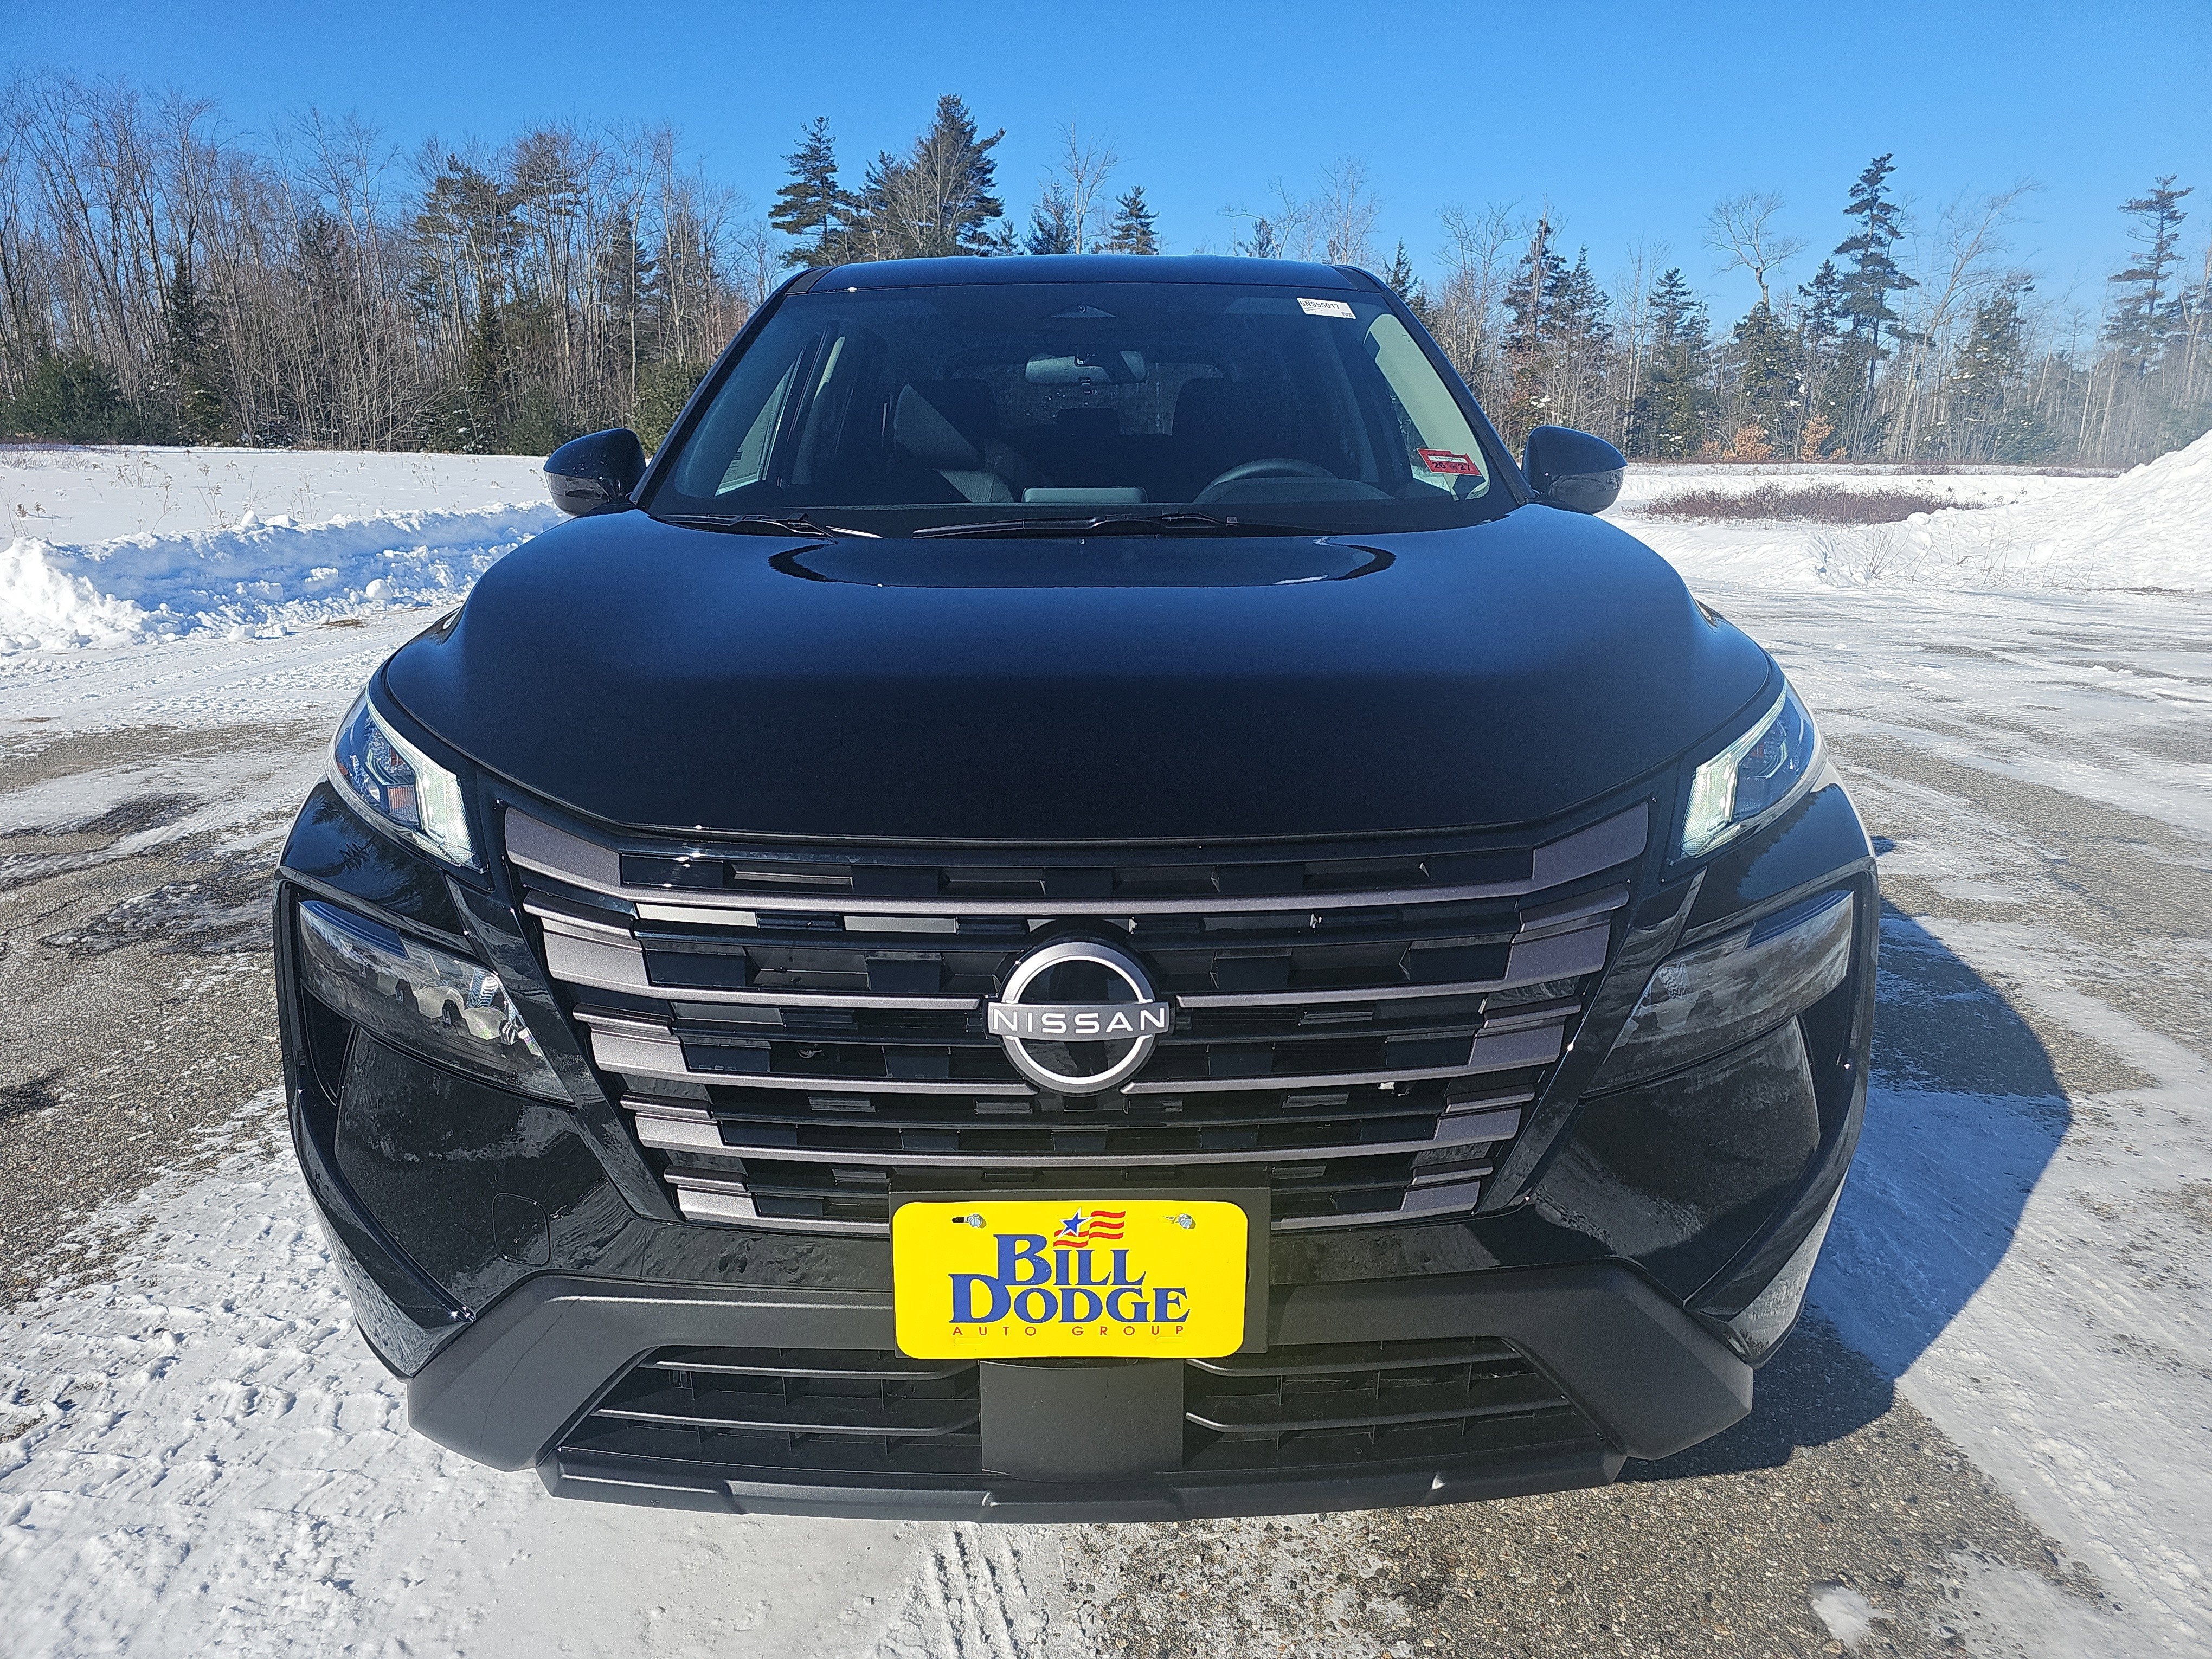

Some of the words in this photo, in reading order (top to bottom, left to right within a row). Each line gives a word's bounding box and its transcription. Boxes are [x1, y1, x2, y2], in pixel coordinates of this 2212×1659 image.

[1458, 463, 1470, 471] 27
[993, 1007, 1165, 1034] NISSAN
[993, 1234, 1147, 1286] BILL
[948, 1274, 1191, 1323] DODGE
[952, 1326, 1037, 1336] AUTO
[1072, 1326, 1184, 1336] GROUP
